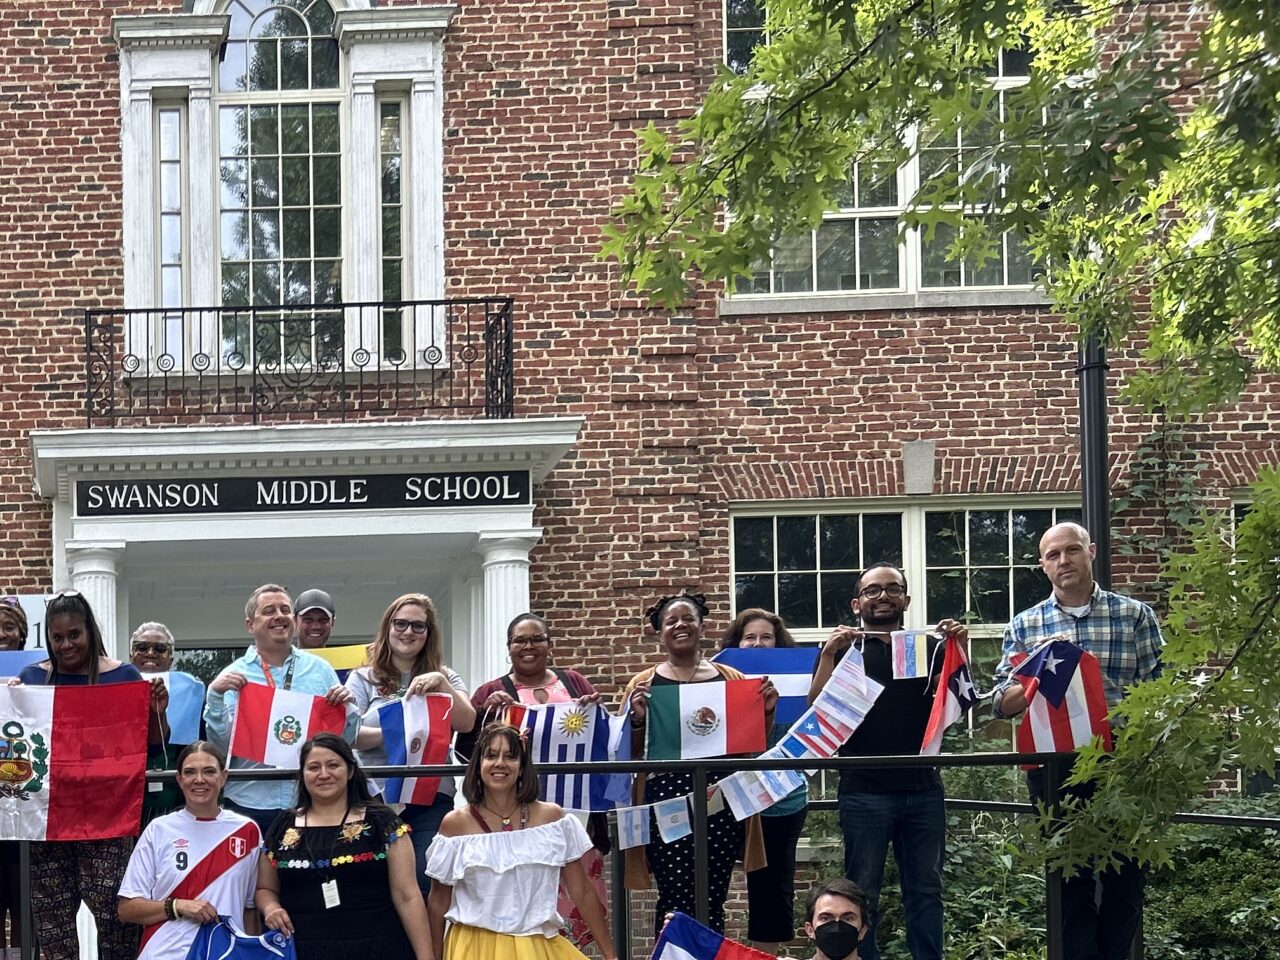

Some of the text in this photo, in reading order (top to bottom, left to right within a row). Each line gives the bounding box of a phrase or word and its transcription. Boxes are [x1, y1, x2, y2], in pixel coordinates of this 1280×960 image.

[87, 475, 520, 509] SWANSON MIDDLE SCHOOL
[32, 622, 44, 649] 1
[175, 851, 189, 871] 9
